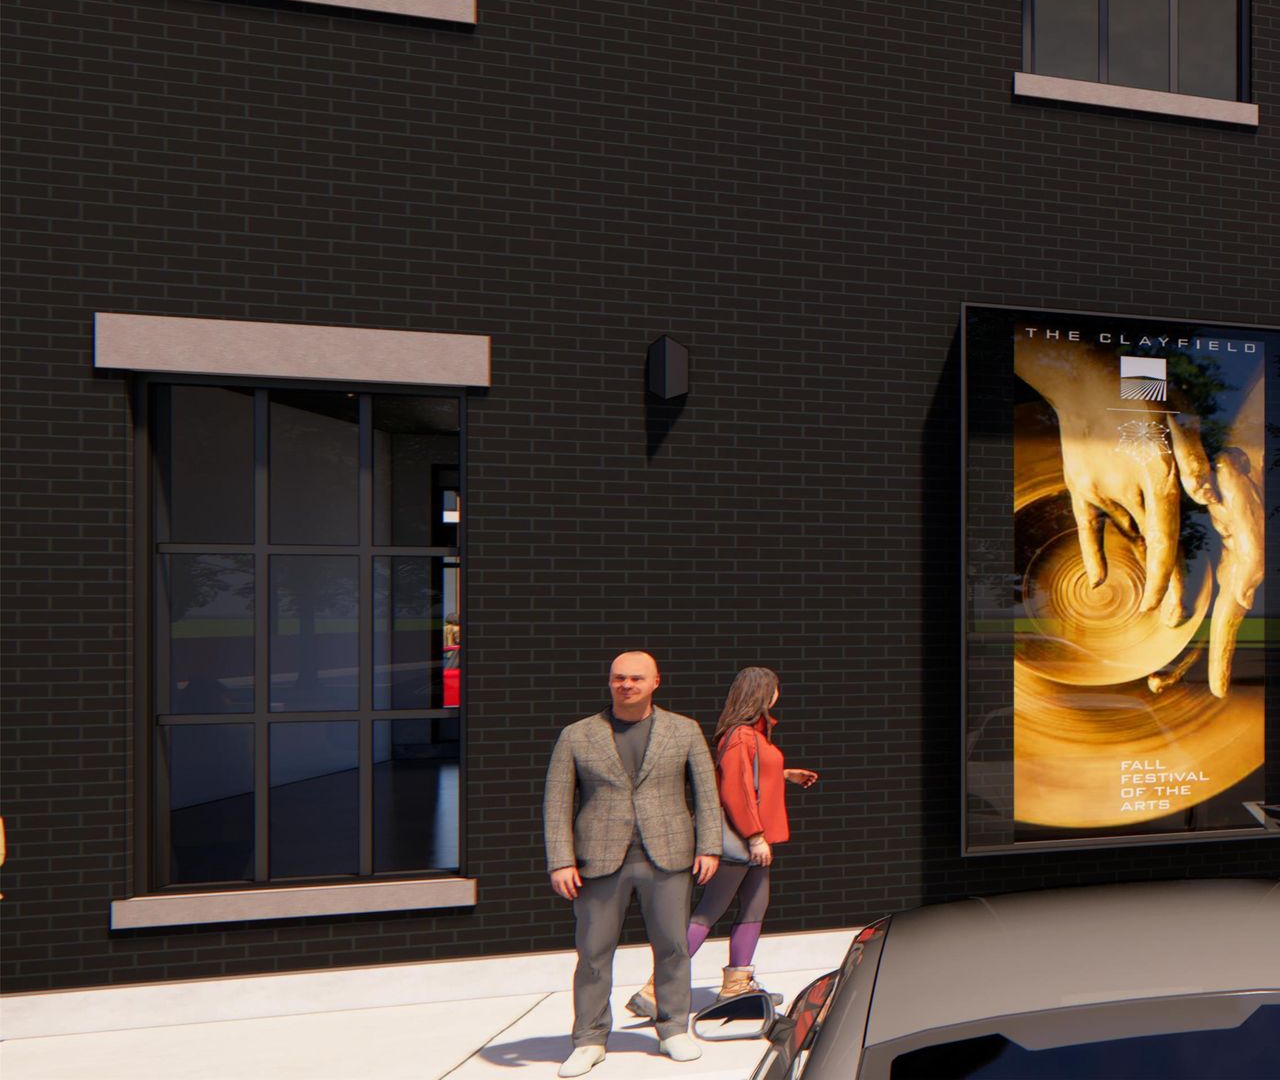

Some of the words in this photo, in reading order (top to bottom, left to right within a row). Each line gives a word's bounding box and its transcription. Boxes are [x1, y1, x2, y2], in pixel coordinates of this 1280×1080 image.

[1025, 327, 1080, 341] THE
[1099, 332, 1256, 353] CLAYFIELD
[1120, 759, 1167, 772] FALL
[1120, 771, 1210, 785] FESTIVAL
[1120, 786, 1147, 798] OF
[1153, 784, 1192, 796] THE
[1120, 800, 1170, 812] ARTS
